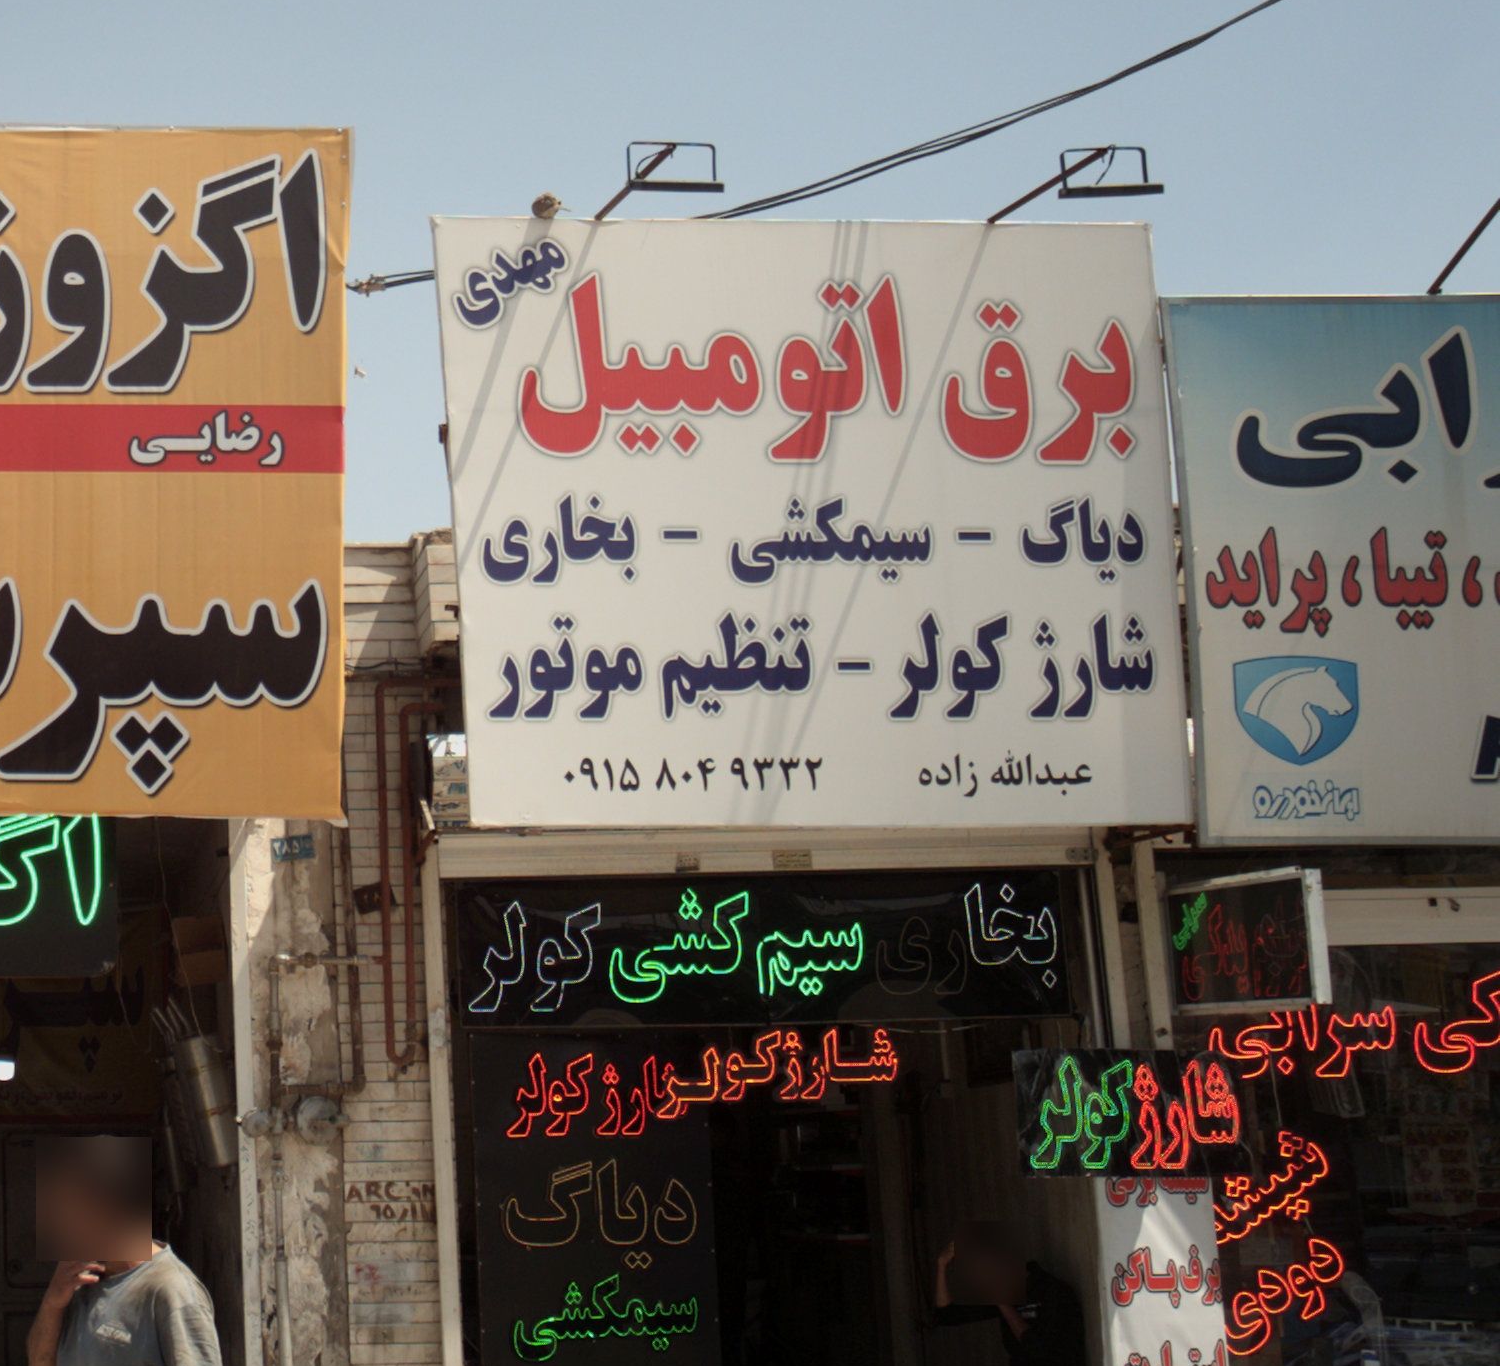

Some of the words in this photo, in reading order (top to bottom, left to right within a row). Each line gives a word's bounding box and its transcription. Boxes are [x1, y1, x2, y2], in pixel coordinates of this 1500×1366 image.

[455, 238, 568, 327] مهدی
[520, 275, 905, 462] اتومبیل
[942, 301, 1135, 462] برق
[130, 412, 285, 467] رضایی
[482, 494, 637, 583] بخاری
[731, 497, 932, 584] سیمکشی
[1022, 496, 1145, 583] دیاگ
[1206, 525, 1332, 637] پراید
[487, 615, 643, 719] موتور
[661, 613, 813, 719] تنظیم
[890, 613, 1008, 719] کولر
[1030, 613, 1155, 719] شارژ
[918, 755, 979, 797] زاده
[467, 900, 602, 1013] کولر
[608, 888, 749, 1004] کشی
[755, 922, 864, 997] سیم
[507, 1052, 593, 1138] کولر
[1030, 1055, 1133, 1170] کولر
[1130, 1059, 1240, 1170] شارژ
[505, 1158, 697, 1270] دیاگ
[1214, 1130, 1330, 1245] شیش
[1225, 1238, 1345, 1356] دودی
